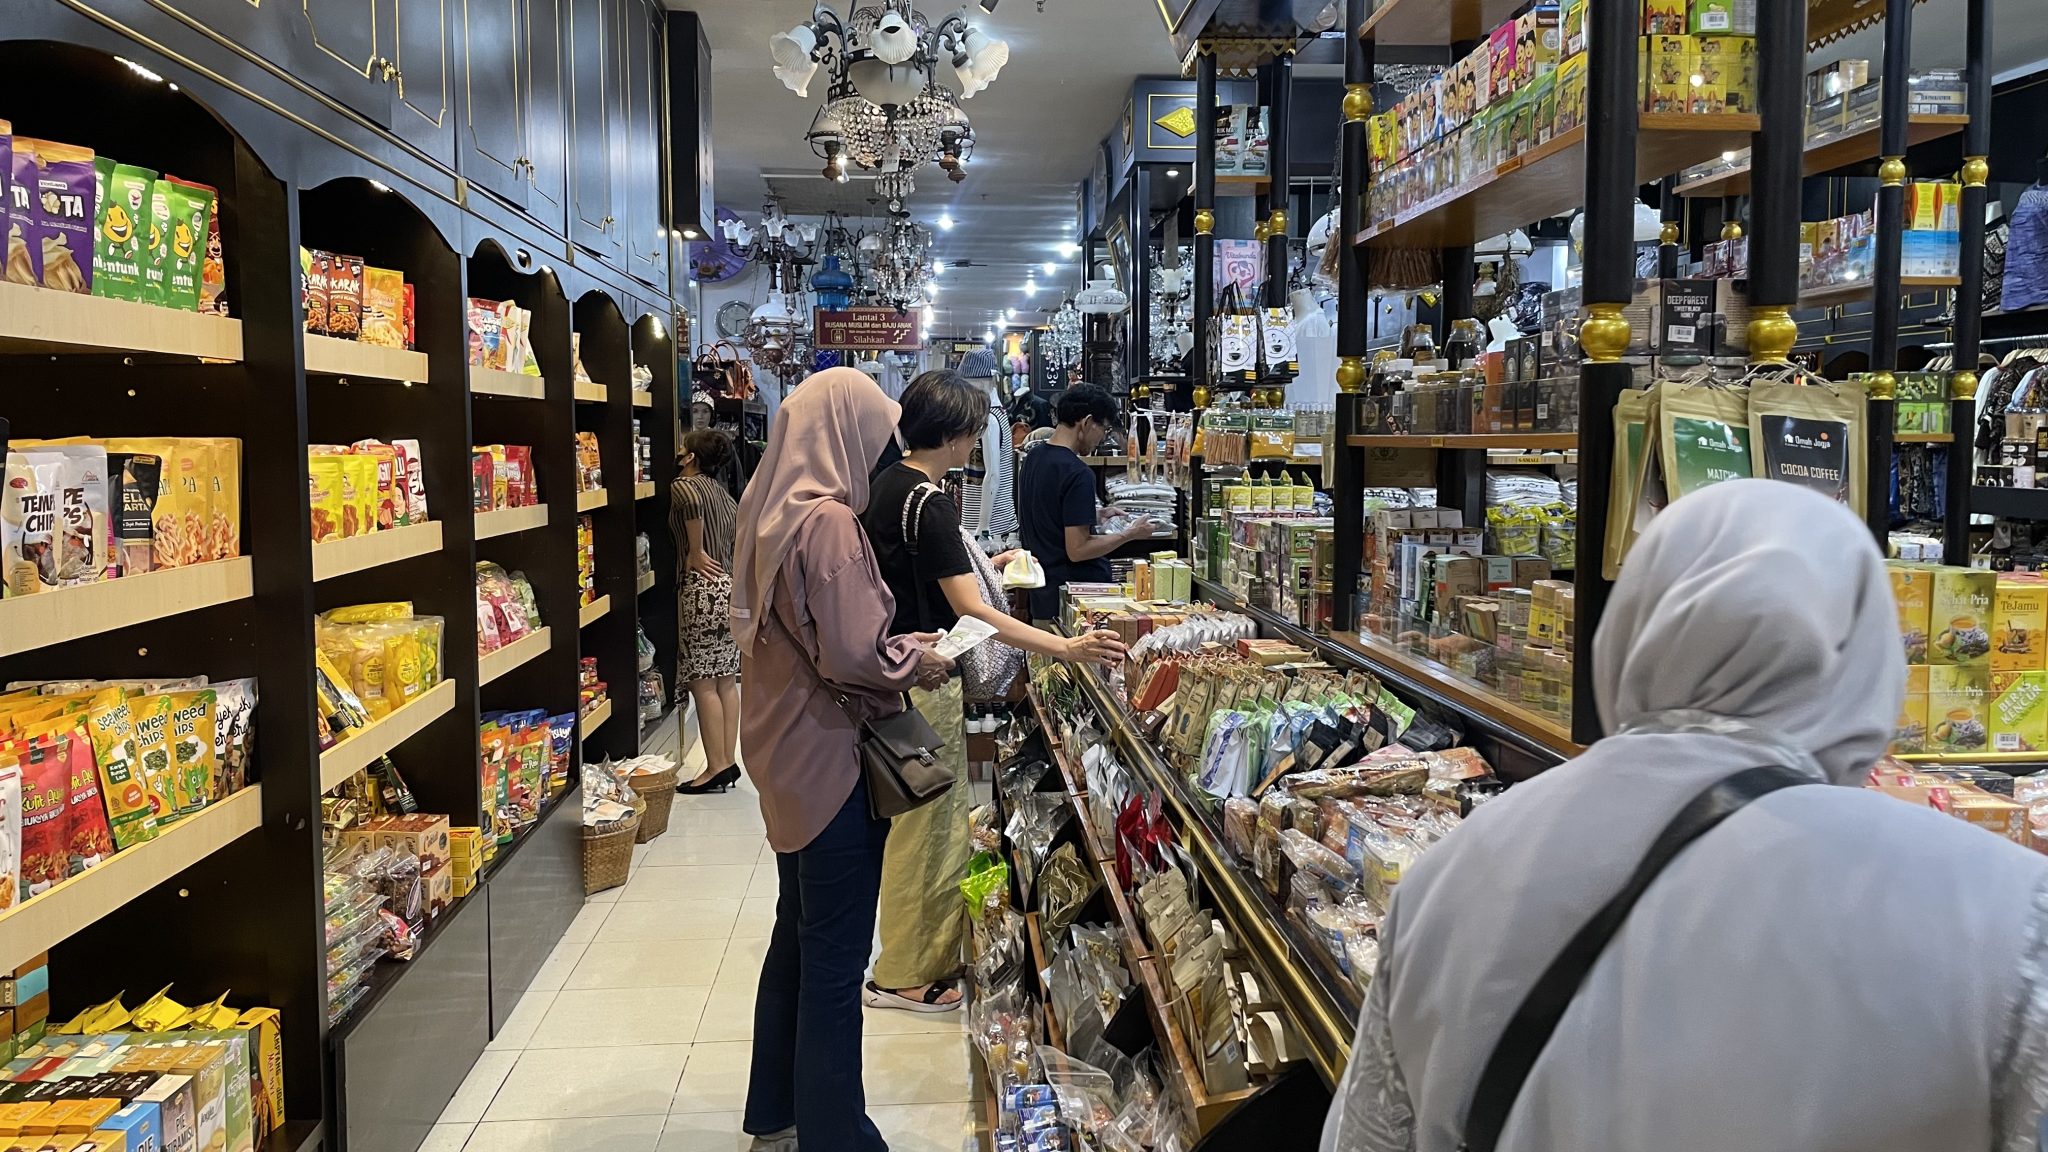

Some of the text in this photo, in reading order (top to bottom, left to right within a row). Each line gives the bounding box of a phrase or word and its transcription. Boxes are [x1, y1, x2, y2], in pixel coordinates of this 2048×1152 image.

[60, 195, 84, 217] TA
[852, 313, 886, 321] Lantai 3
[882, 321, 897, 329] BAJU
[897, 321, 912, 329] ANAK
[853, 335, 885, 344] Silahkan
[1780, 463, 1839, 480] COCOA COFFEE
[1970, 593, 1989, 605] Pria
[2000, 600, 2039, 611] TeJamu
[1965, 685, 1984, 697] Pria
[1998, 682, 2031, 713] BERAS
[2000, 684, 2042, 725] KENCUR
[175, 1112, 186, 1132] PIE
